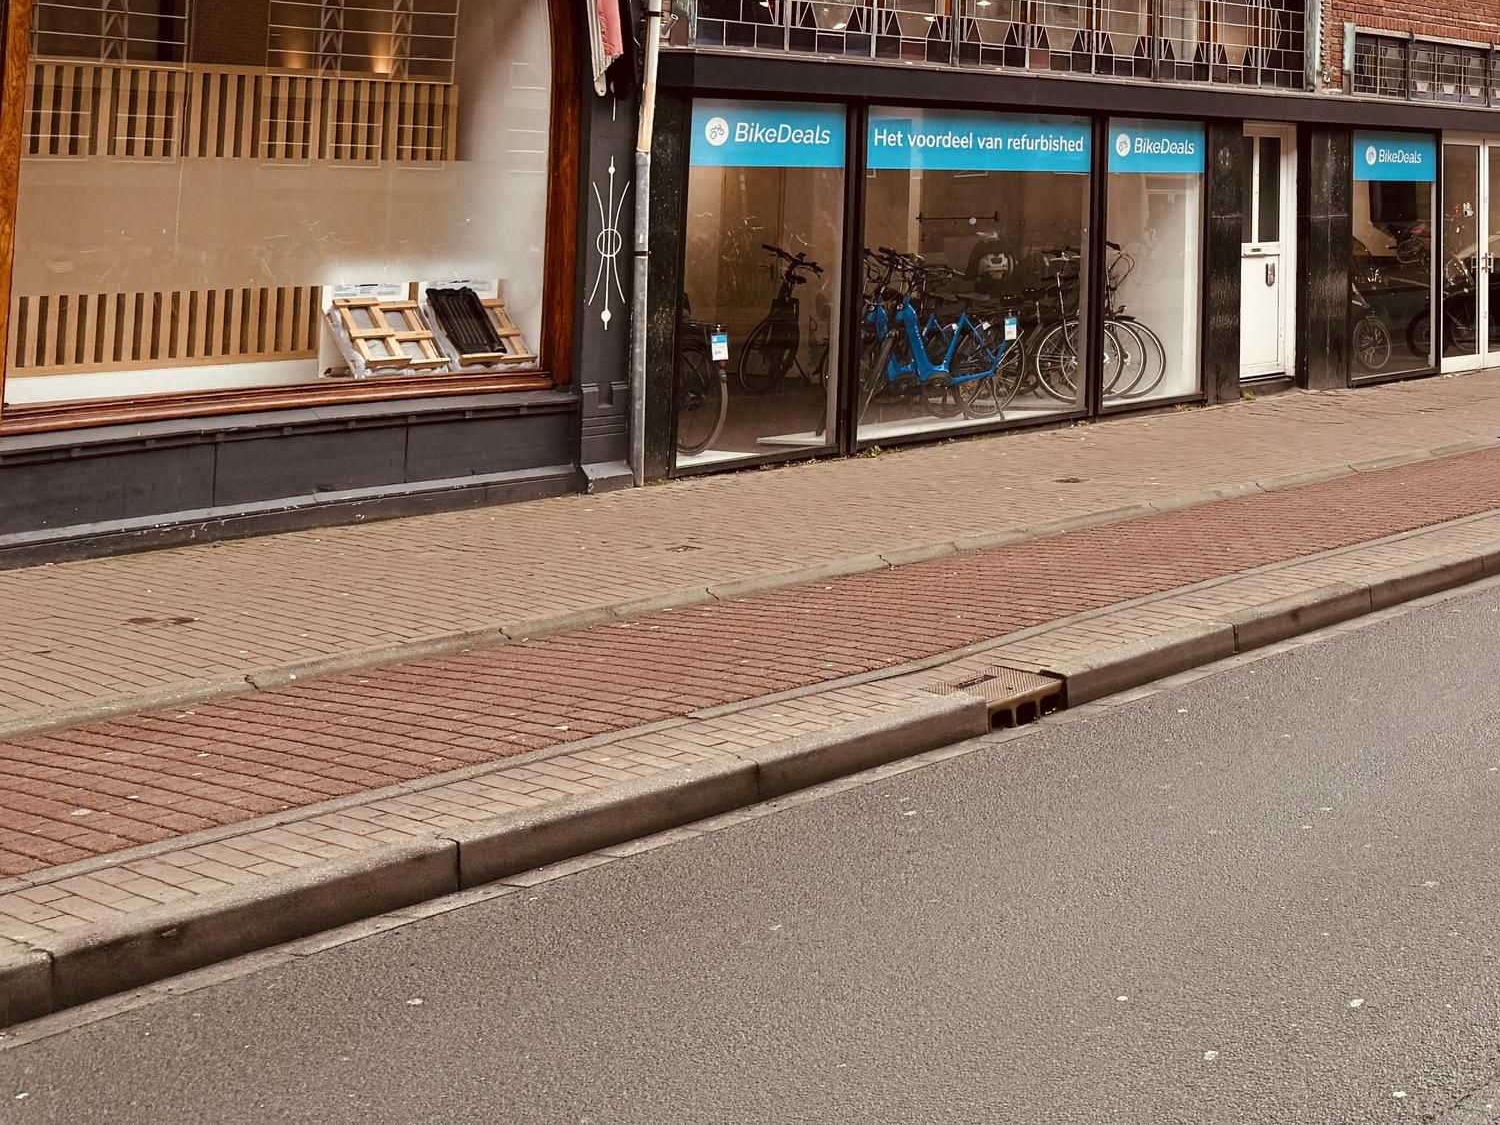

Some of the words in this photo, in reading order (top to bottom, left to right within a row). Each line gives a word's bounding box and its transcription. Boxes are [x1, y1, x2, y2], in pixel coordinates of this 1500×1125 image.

[735, 122, 830, 145] BikeDeals
[873, 128, 903, 147] Het
[908, 131, 973, 149] voordeel
[977, 136, 1003, 150] van
[1007, 133, 1084, 152] refurbished
[1134, 137, 1195, 155] BikeDeals
[1378, 149, 1422, 164] BikeDeals
